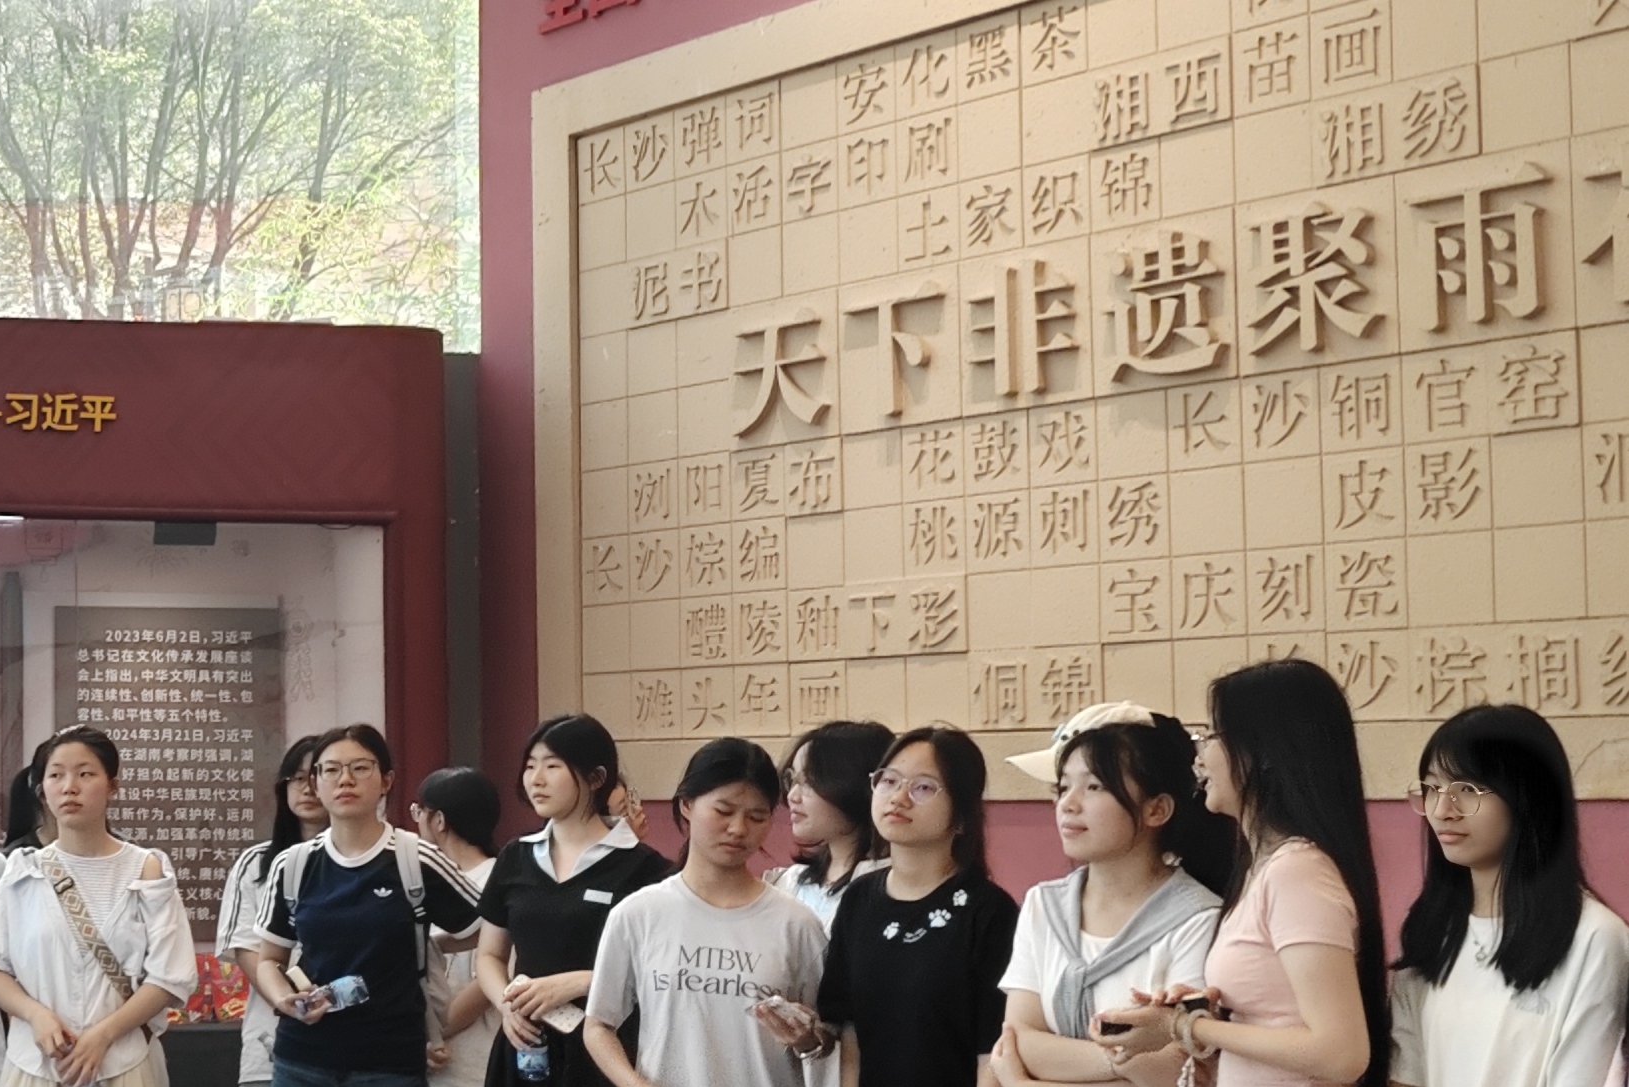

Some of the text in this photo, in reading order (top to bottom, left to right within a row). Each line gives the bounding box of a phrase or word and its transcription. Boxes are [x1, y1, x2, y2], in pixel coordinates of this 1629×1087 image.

[842, 4, 1081, 125] 安化黑茶
[1092, 8, 1383, 145] 湘西苗画
[582, 88, 776, 197] 长沙弹词
[1318, 75, 1470, 179] 湘绣
[679, 116, 954, 237] 木活字印刷
[904, 152, 1154, 265] 土家织锦
[631, 250, 723, 322] 泥书
[1172, 344, 1573, 456] 长沙铜官窑
[632, 448, 836, 522] 浏阳夏布
[907, 410, 1092, 490] 花鼓戏
[908, 478, 1163, 568] 桃源刺绣
[1334, 445, 1484, 531] 皮影
[584, 523, 781, 594] 长沙棕编
[1108, 550, 1401, 636] 宝庆刻瓷
[76, 648, 255, 665] 总书记在文化传承发展座谈
[104, 628, 255, 645] 2023年6月2日，习近平
[684, 587, 958, 662] 醴陵釉下彩
[76, 668, 255, 685] 会上指出，中华文明具有突出
[76, 688, 255, 704] 的连续性、创新性、统一性、包
[635, 670, 842, 732] 滩头年画
[973, 655, 1099, 727] 侗锦
[76, 708, 229, 724] 容性、和平性等五个特性。
[111, 826, 255, 843] 资源，加强革命传统和
[171, 847, 243, 862] 引导广大干
[652, 969, 670, 992] is
[677, 944, 763, 973] MTBW
